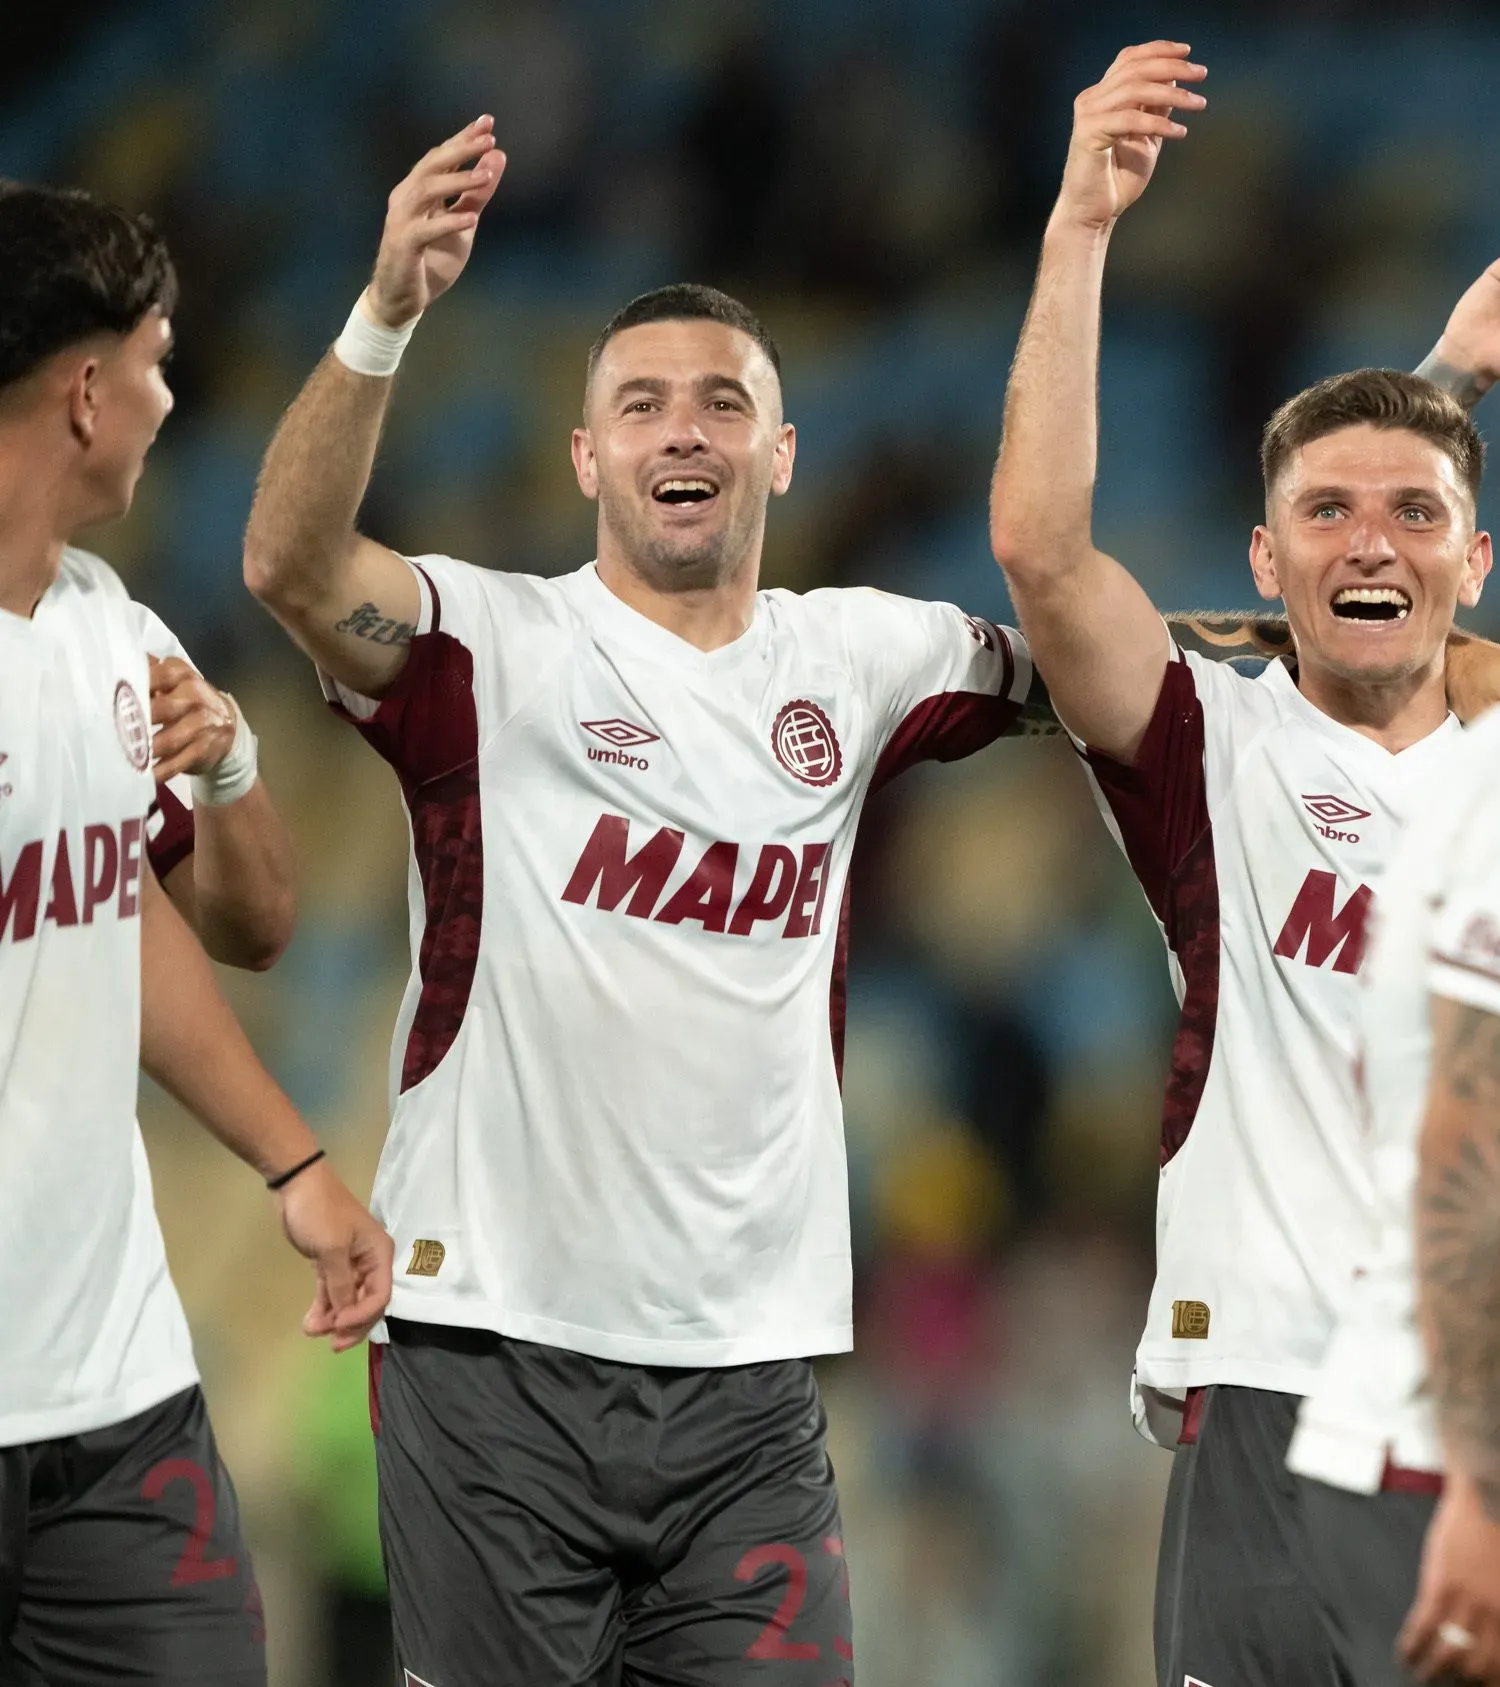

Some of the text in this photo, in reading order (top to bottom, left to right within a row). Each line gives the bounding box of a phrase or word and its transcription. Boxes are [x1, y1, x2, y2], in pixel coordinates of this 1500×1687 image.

[586, 746, 650, 771] umbro
[559, 812, 835, 940] MAPEI
[1272, 868, 1377, 976] M
